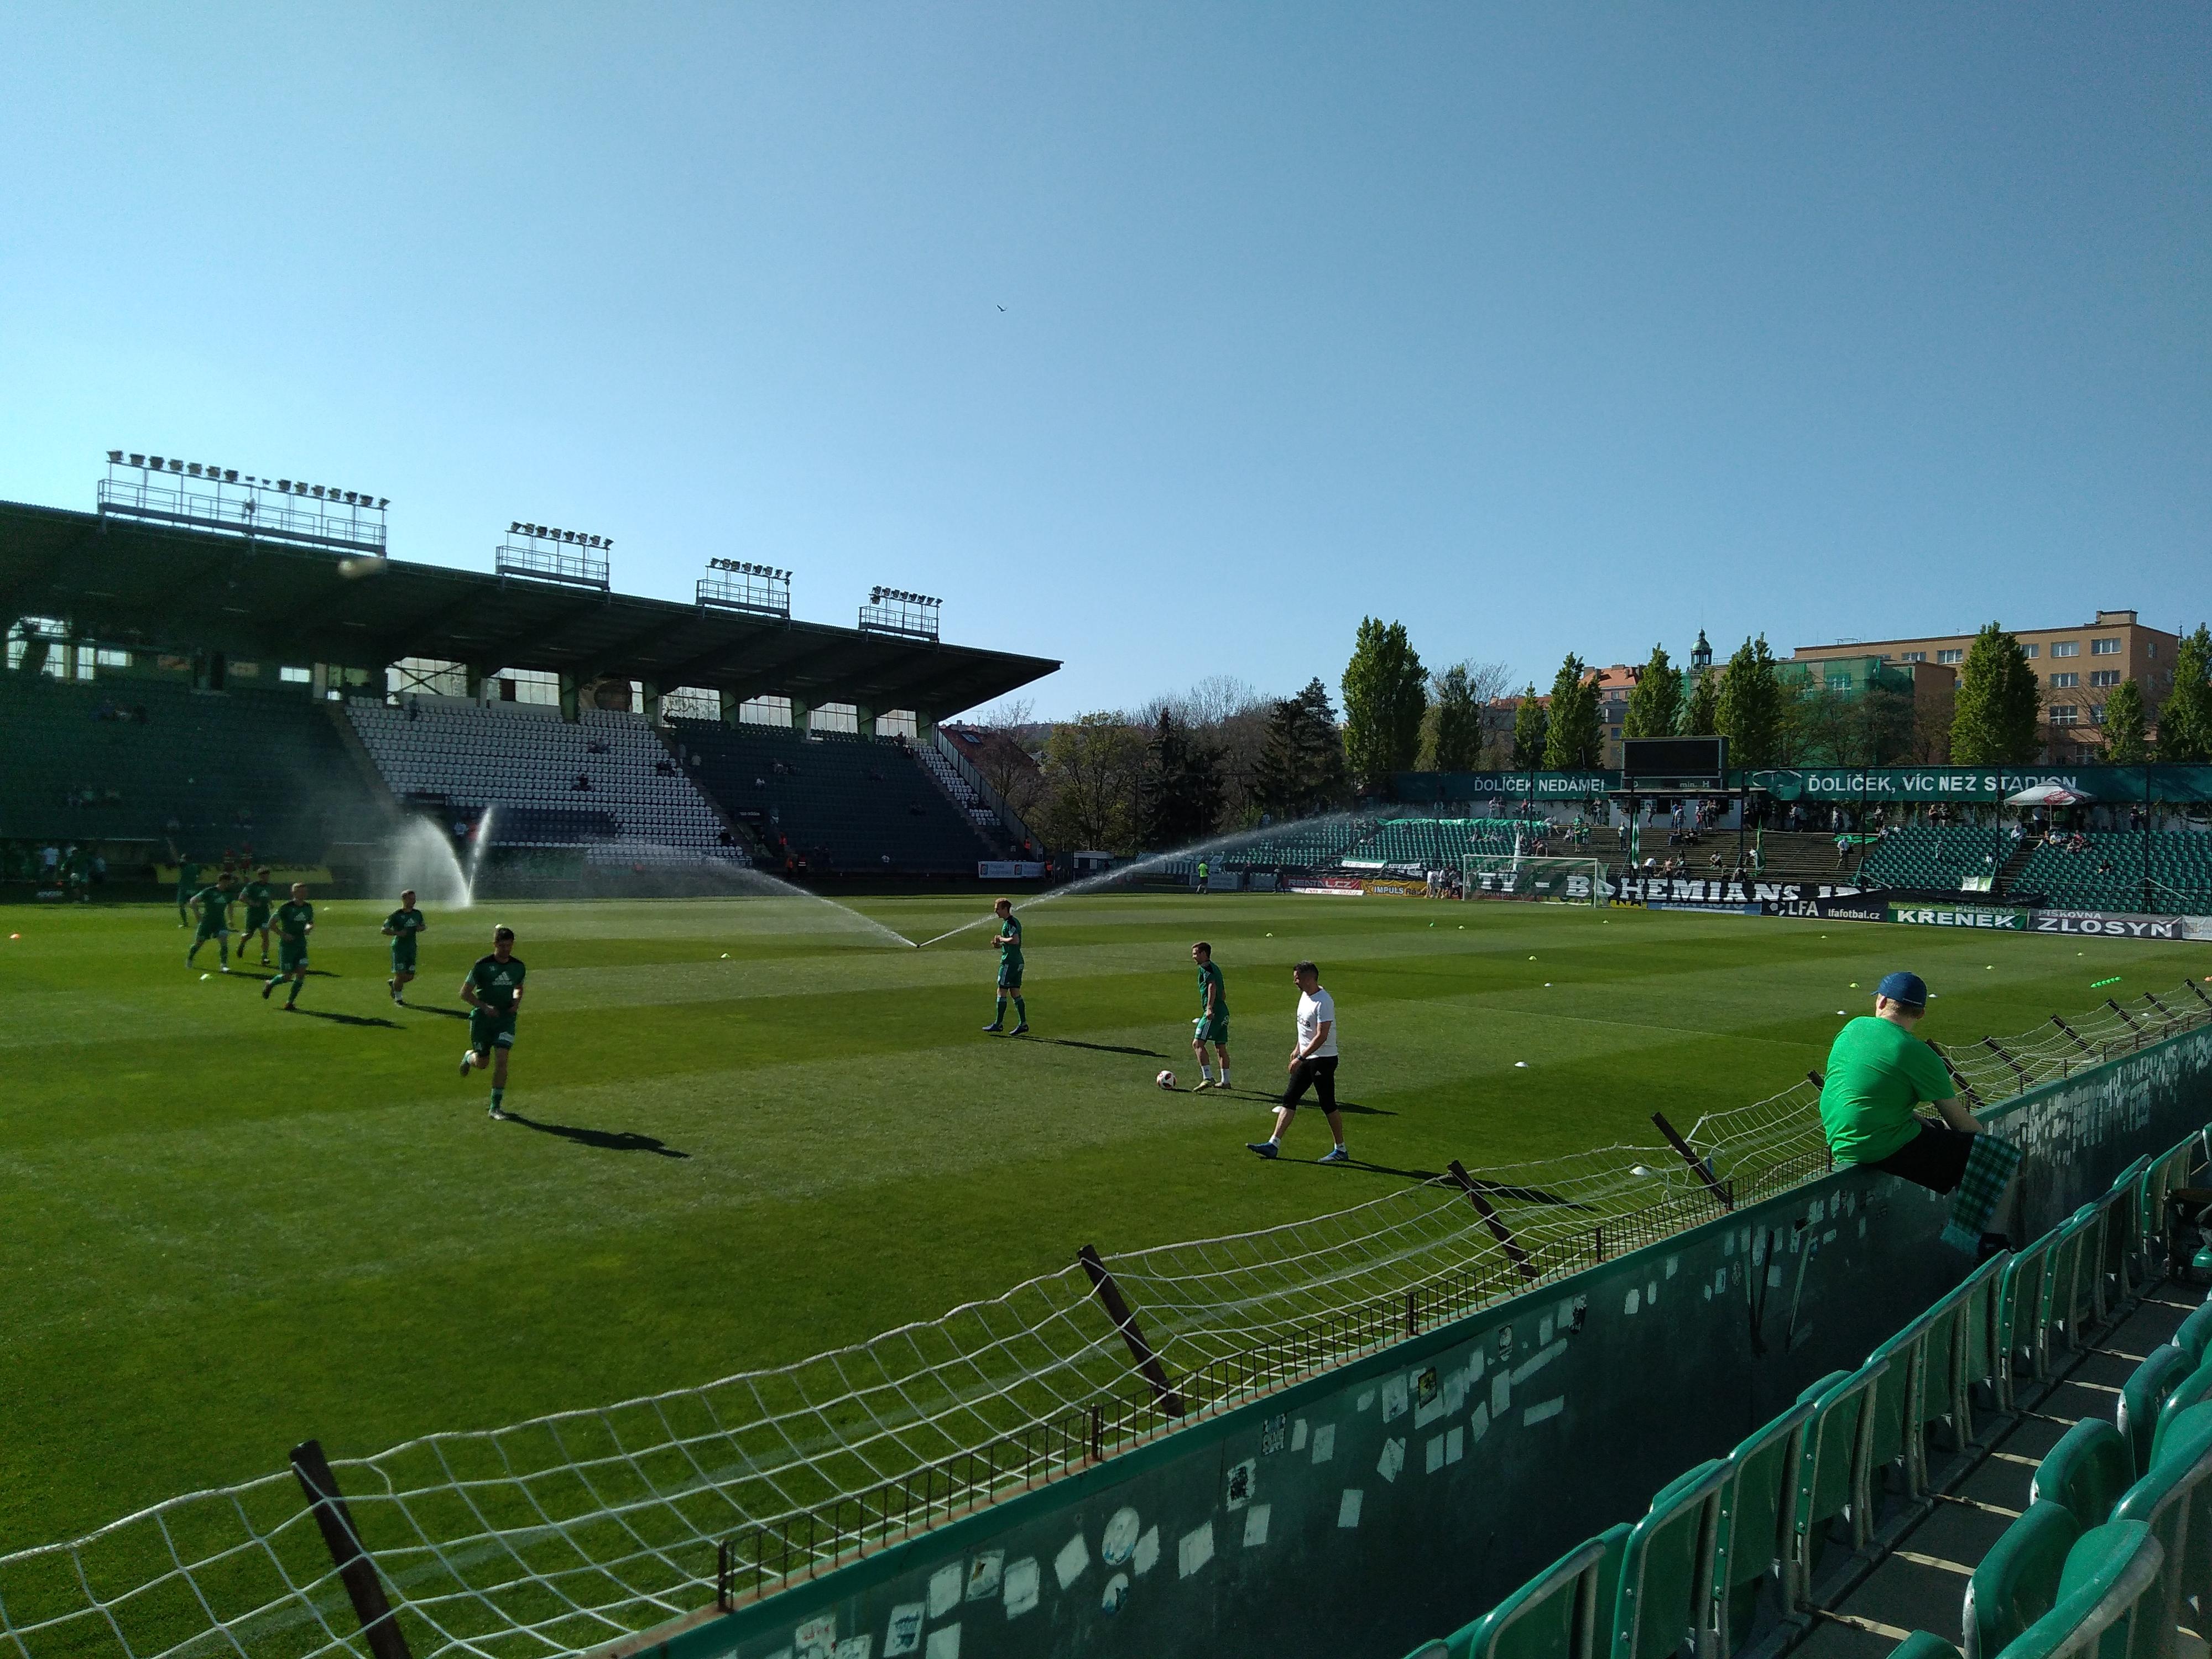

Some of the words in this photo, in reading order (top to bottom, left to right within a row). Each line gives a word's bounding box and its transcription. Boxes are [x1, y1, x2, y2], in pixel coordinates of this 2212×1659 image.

[1474, 776, 1535, 792] ĎOLÍČEK
[1538, 776, 1605, 792] NEDÁME!
[1808, 774, 1896, 794] ĎOLÍČEK,
[1902, 773, 1934, 791] VÍC
[1938, 774, 1977, 791] NEŽ
[1374, 885, 1404, 895] IMPULS
[1788, 900, 1819, 916] LFA
[1828, 908, 1880, 920] lfafotbal.cz
[1955, 905, 2015, 914] PÍSKOVNA
[2039, 910, 2102, 919] PÍSKOVNA
[1897, 908, 2016, 928] KŘENEK
[2037, 917, 2172, 937] ZLOSYŇ
